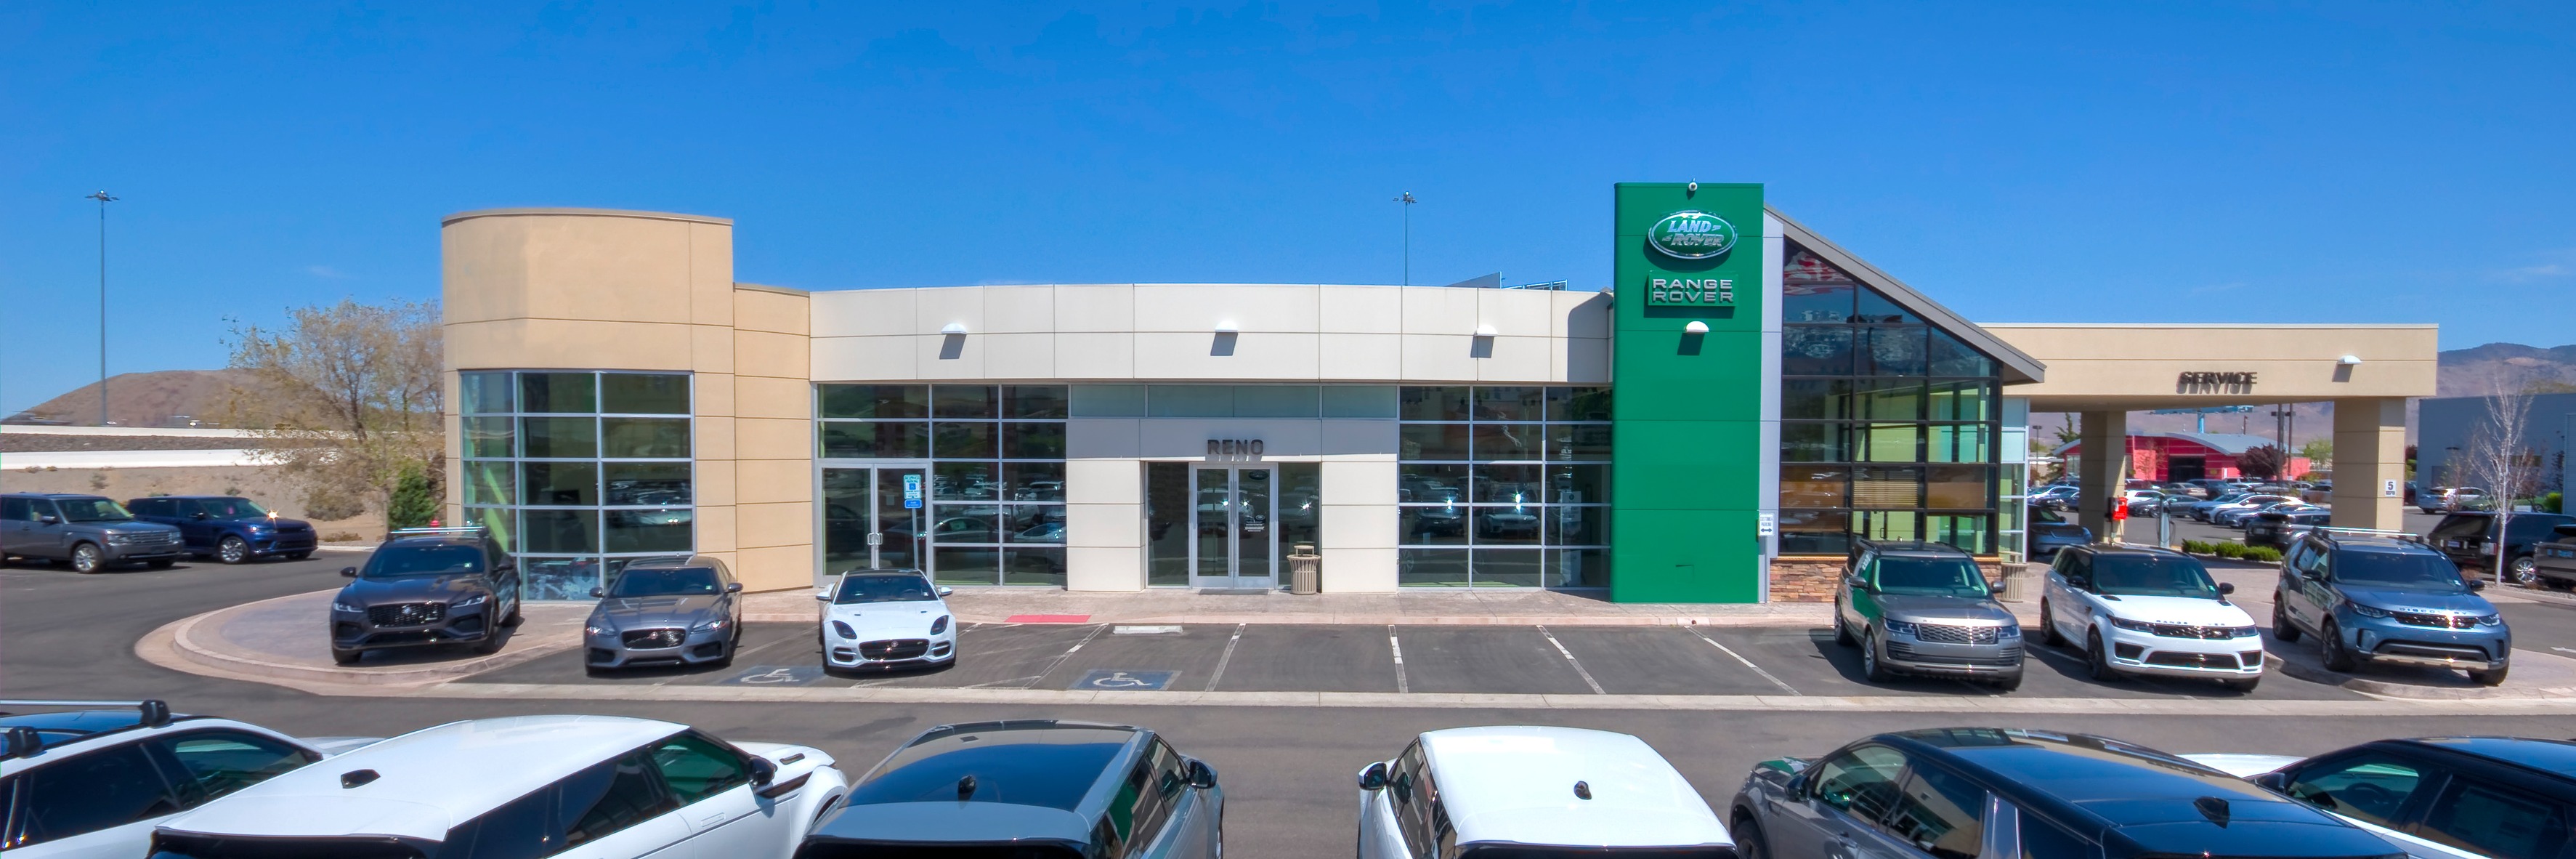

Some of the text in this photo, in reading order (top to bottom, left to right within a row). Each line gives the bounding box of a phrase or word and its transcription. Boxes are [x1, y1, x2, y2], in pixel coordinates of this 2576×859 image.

[1667, 220, 1712, 233] LAND
[1671, 233, 1724, 246] ROVER
[1653, 278, 1733, 289] RANGE
[1653, 291, 1733, 302] ROVER
[2179, 371, 2257, 384] SERVICE
[1207, 439, 1264, 455] RENO
[2388, 481, 2394, 491] 5
